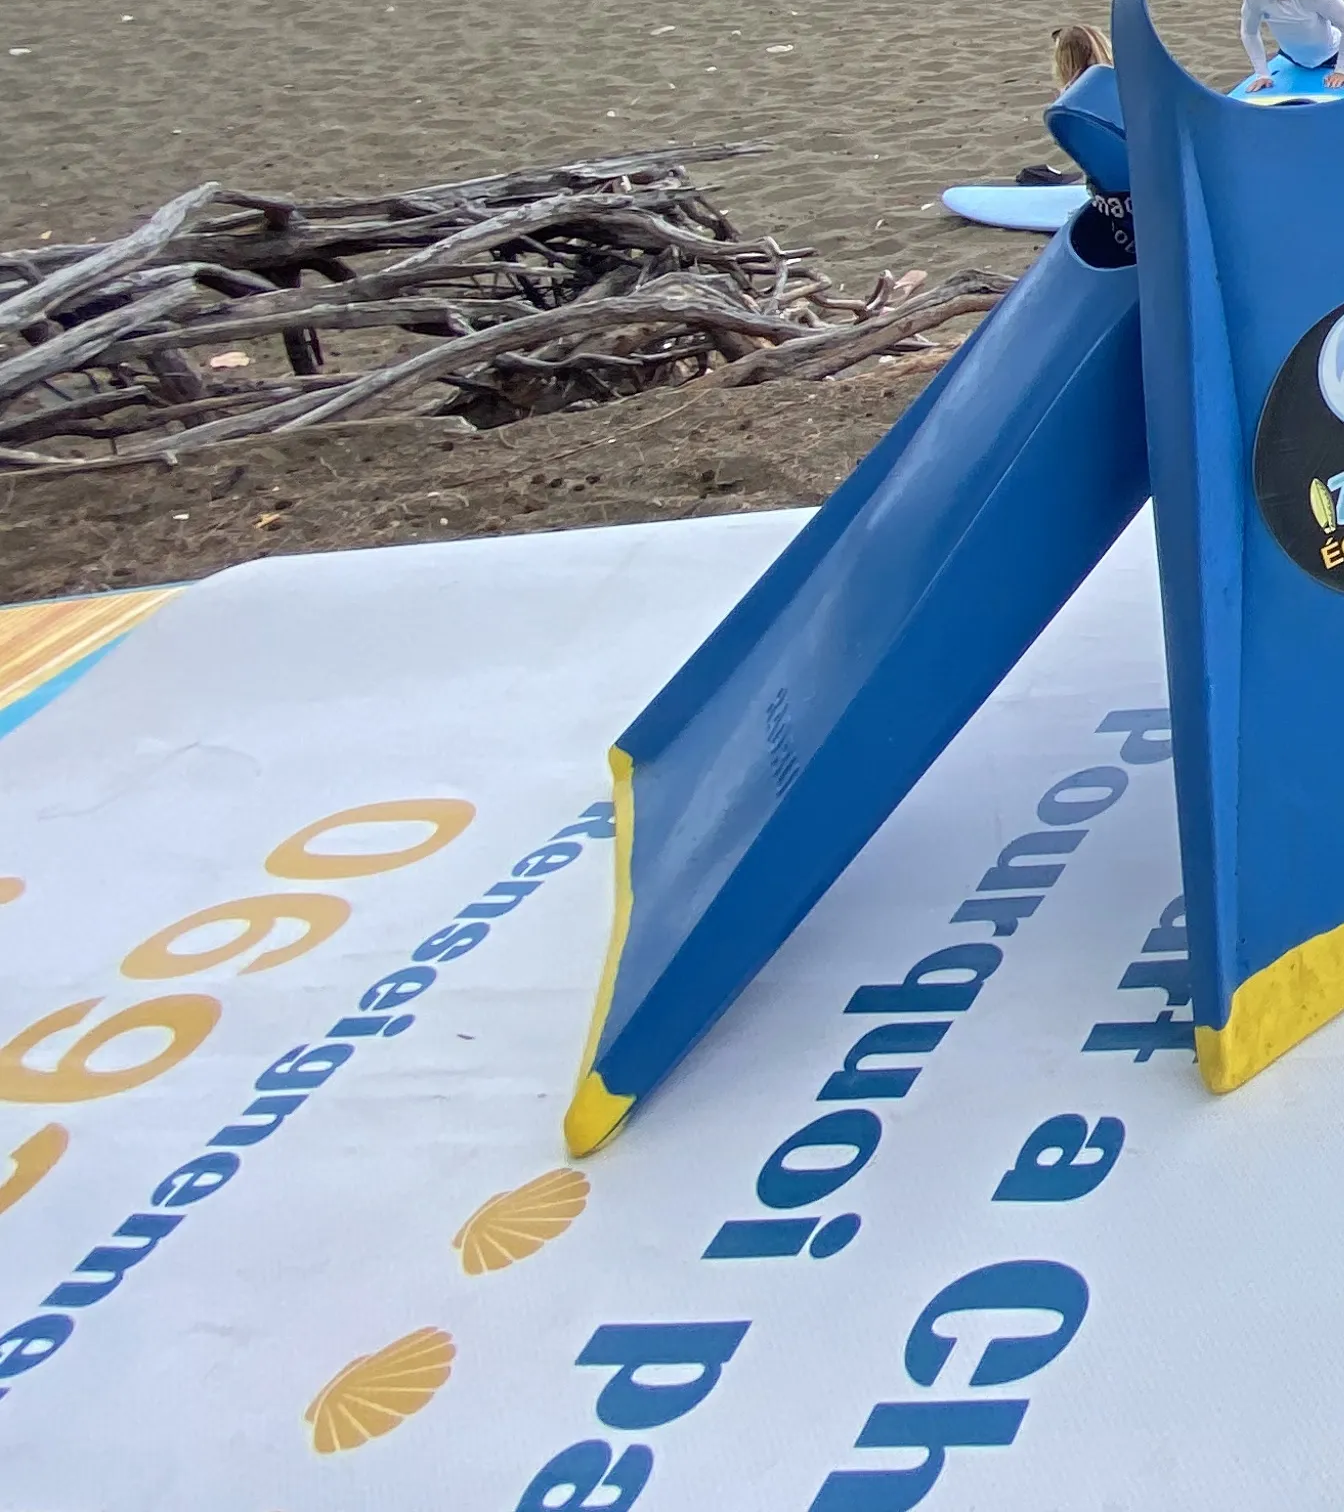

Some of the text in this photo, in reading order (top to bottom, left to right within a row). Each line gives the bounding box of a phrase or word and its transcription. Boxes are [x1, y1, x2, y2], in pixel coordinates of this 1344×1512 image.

[0, 798, 477, 1216] 069
[0, 801, 615, 1402] Renseigneme
[701, 708, 1173, 1260] Pourquoi
